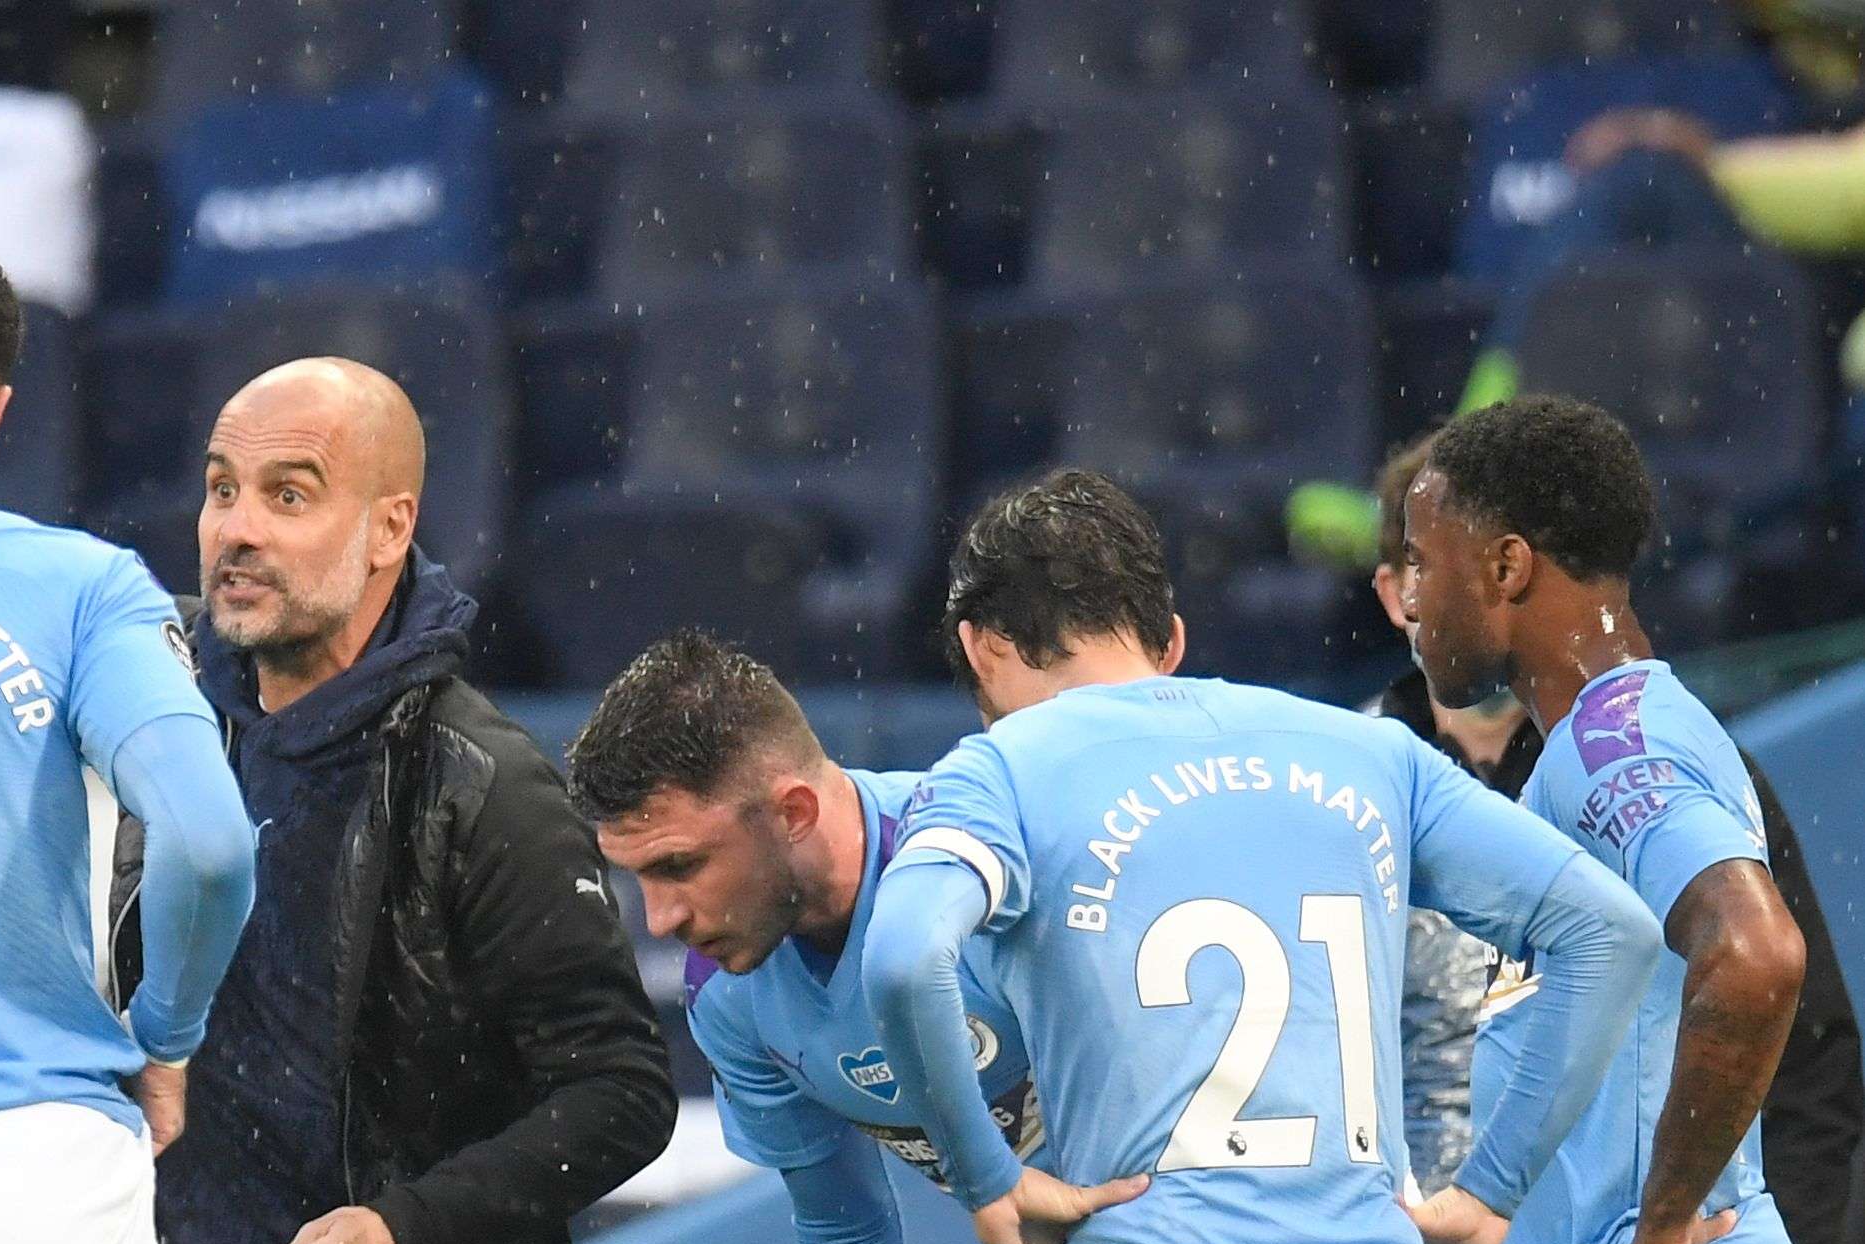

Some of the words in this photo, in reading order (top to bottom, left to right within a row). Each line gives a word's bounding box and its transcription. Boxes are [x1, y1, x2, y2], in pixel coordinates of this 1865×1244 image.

[1066, 786, 1162, 933] BLACK
[1162, 755, 1274, 806] LIVES
[1289, 761, 1399, 916] MATTER
[1577, 760, 1675, 841] NEXEN
[855, 1063, 891, 1086] NHS
[1135, 893, 1383, 1173] 21
